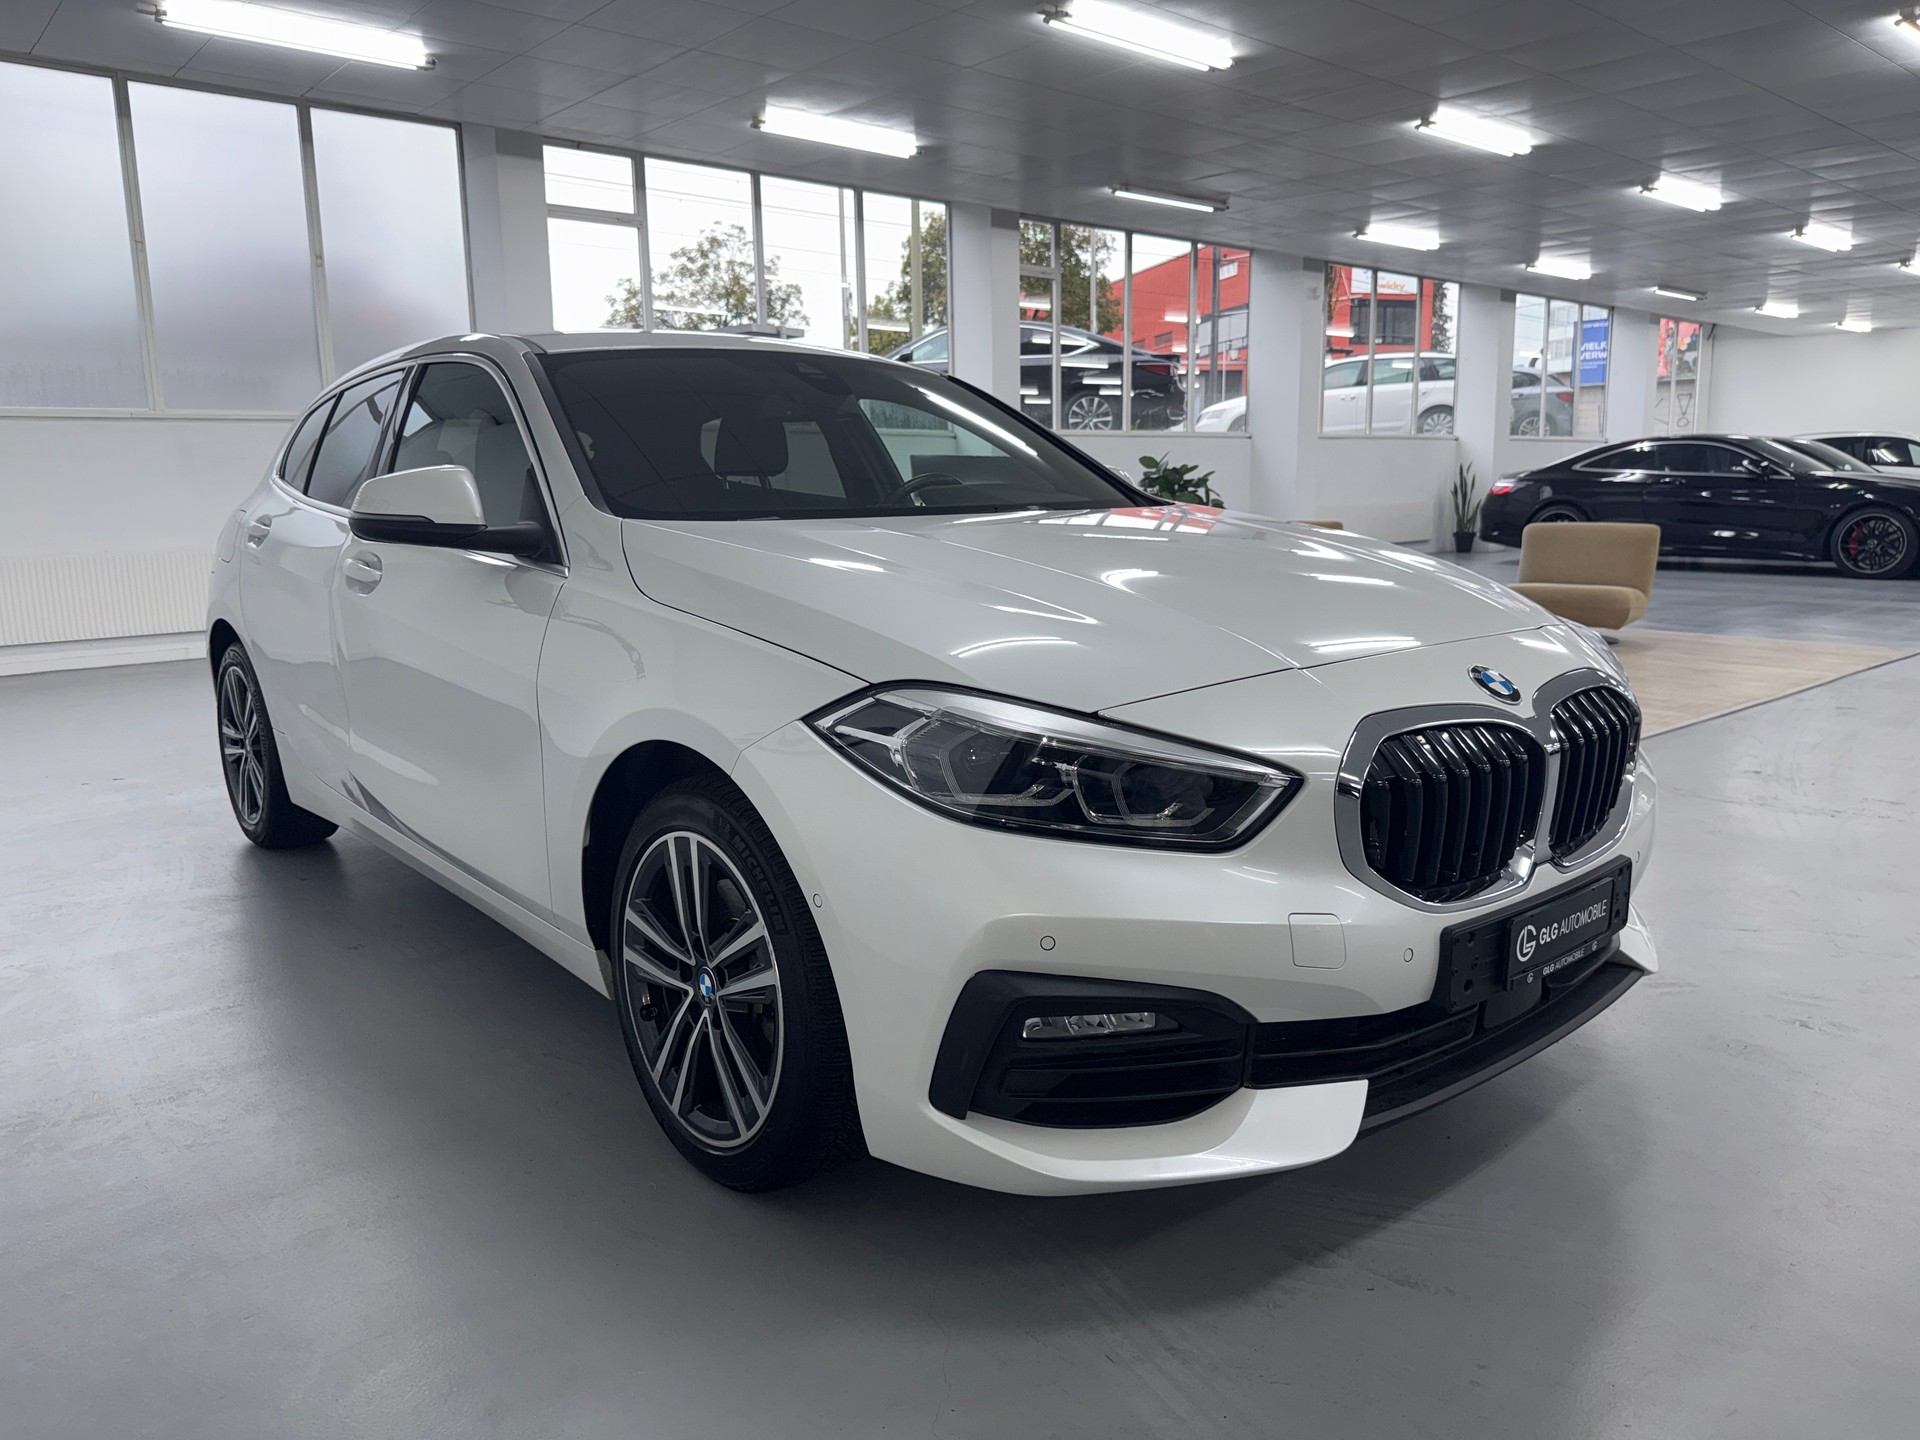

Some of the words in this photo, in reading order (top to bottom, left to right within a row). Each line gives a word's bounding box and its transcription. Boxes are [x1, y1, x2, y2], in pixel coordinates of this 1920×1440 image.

[730, 834, 788, 935] MICHELIN
[1539, 922, 1559, 945] GLG
[1559, 899, 1608, 936] AUTOMOBILE
[1542, 963, 1555, 975] GLG
[1554, 948, 1585, 970] AUTOMOBILE
